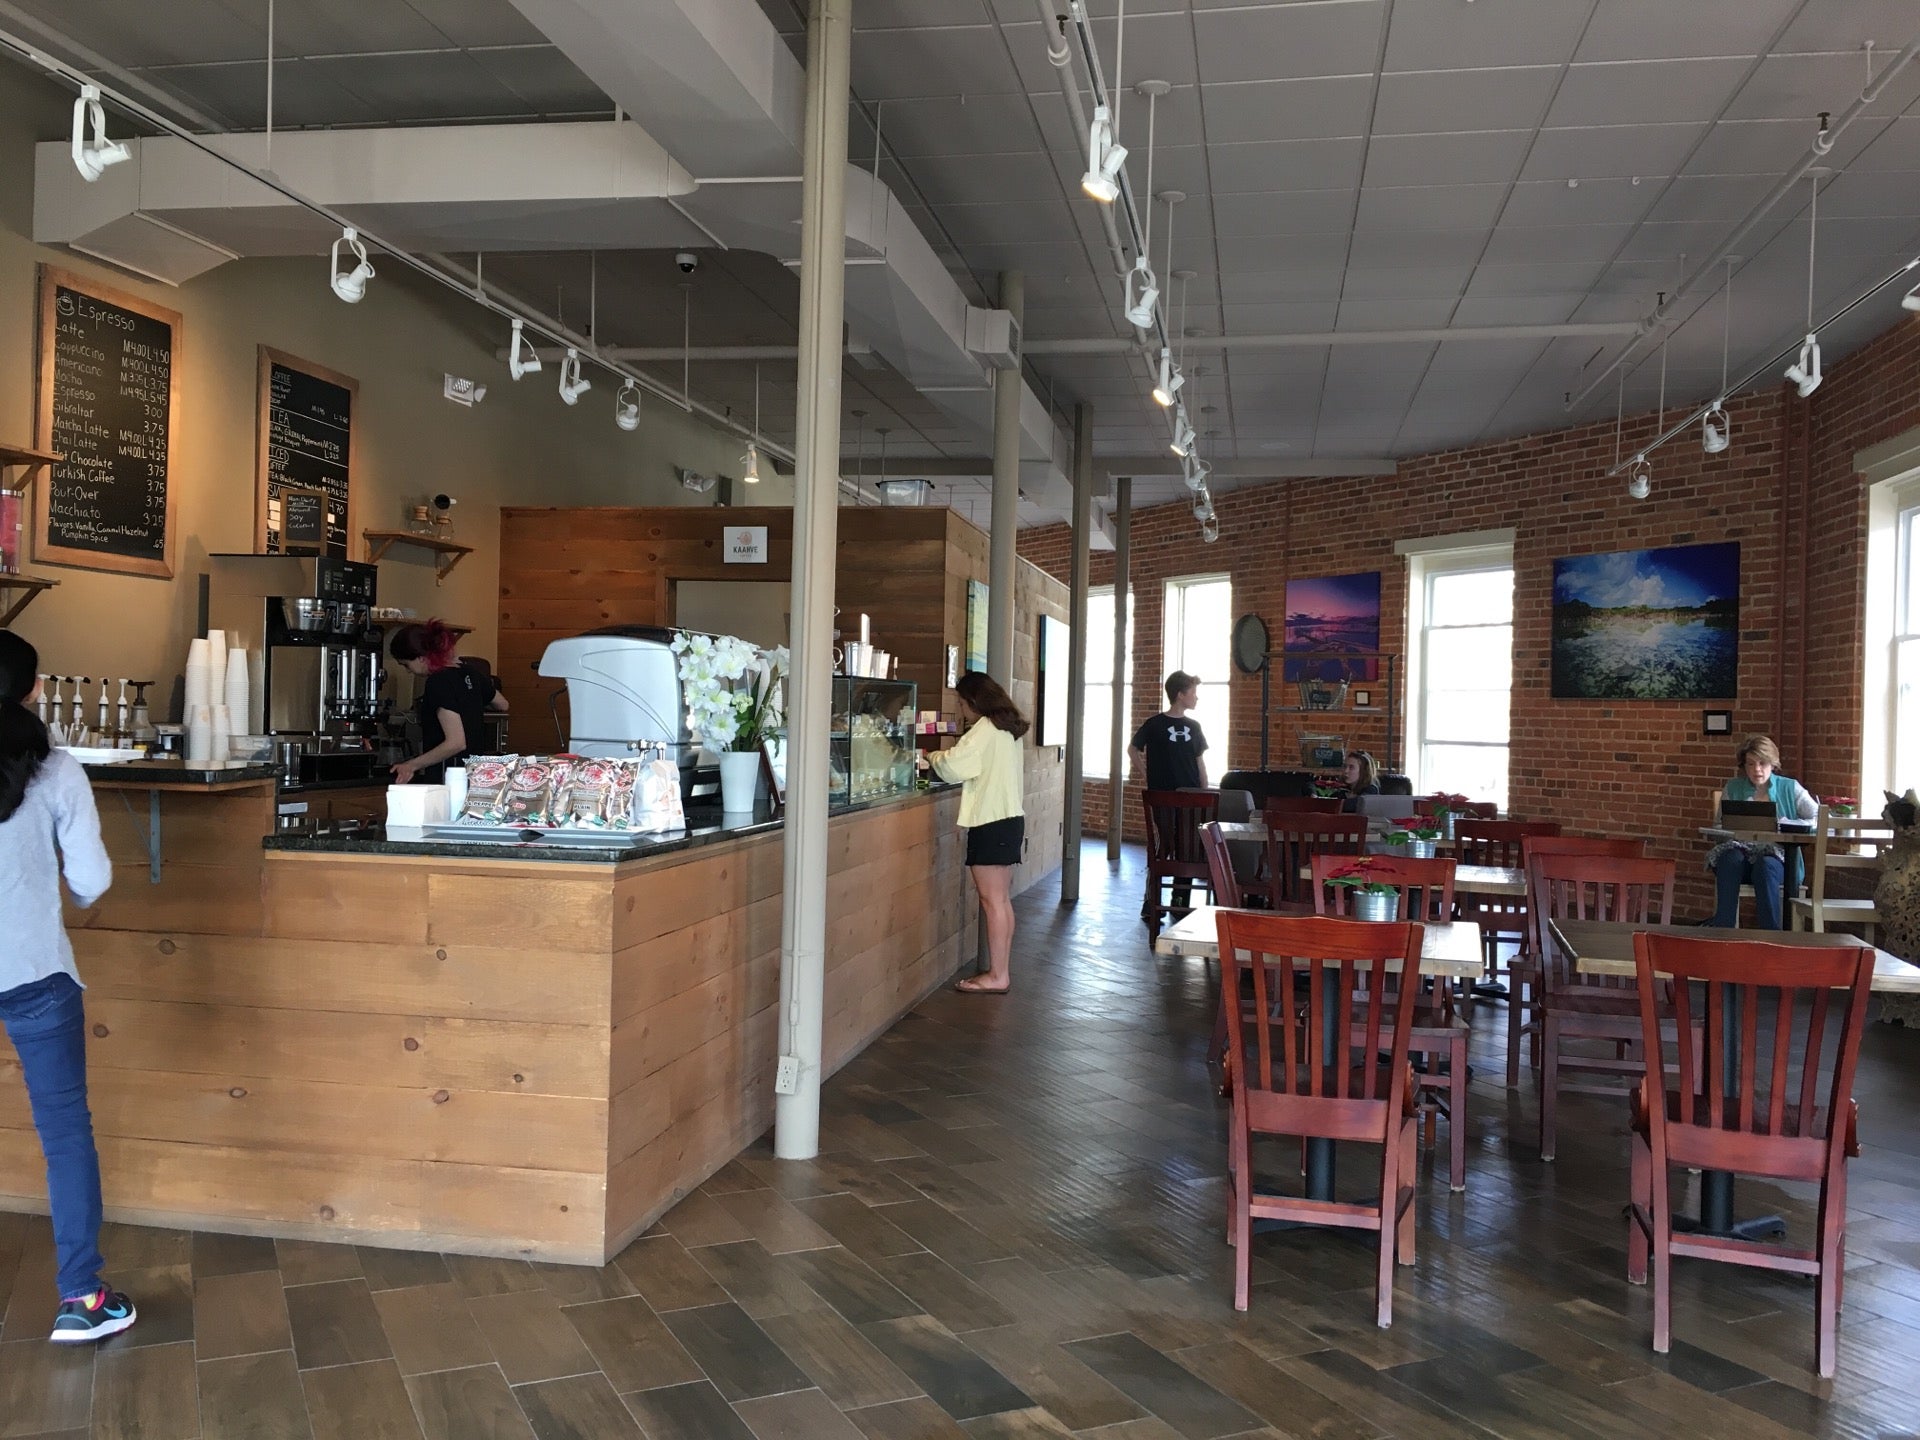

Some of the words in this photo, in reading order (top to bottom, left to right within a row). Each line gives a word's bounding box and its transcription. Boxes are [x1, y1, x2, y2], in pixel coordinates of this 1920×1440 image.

[78, 296, 135, 331] Espresso
[84, 420, 110, 439] Latte
[73, 433, 98, 451] Latte
[70, 450, 113, 470] Chocolate
[52, 463, 86, 481] Turkish
[88, 469, 115, 484] Coffee
